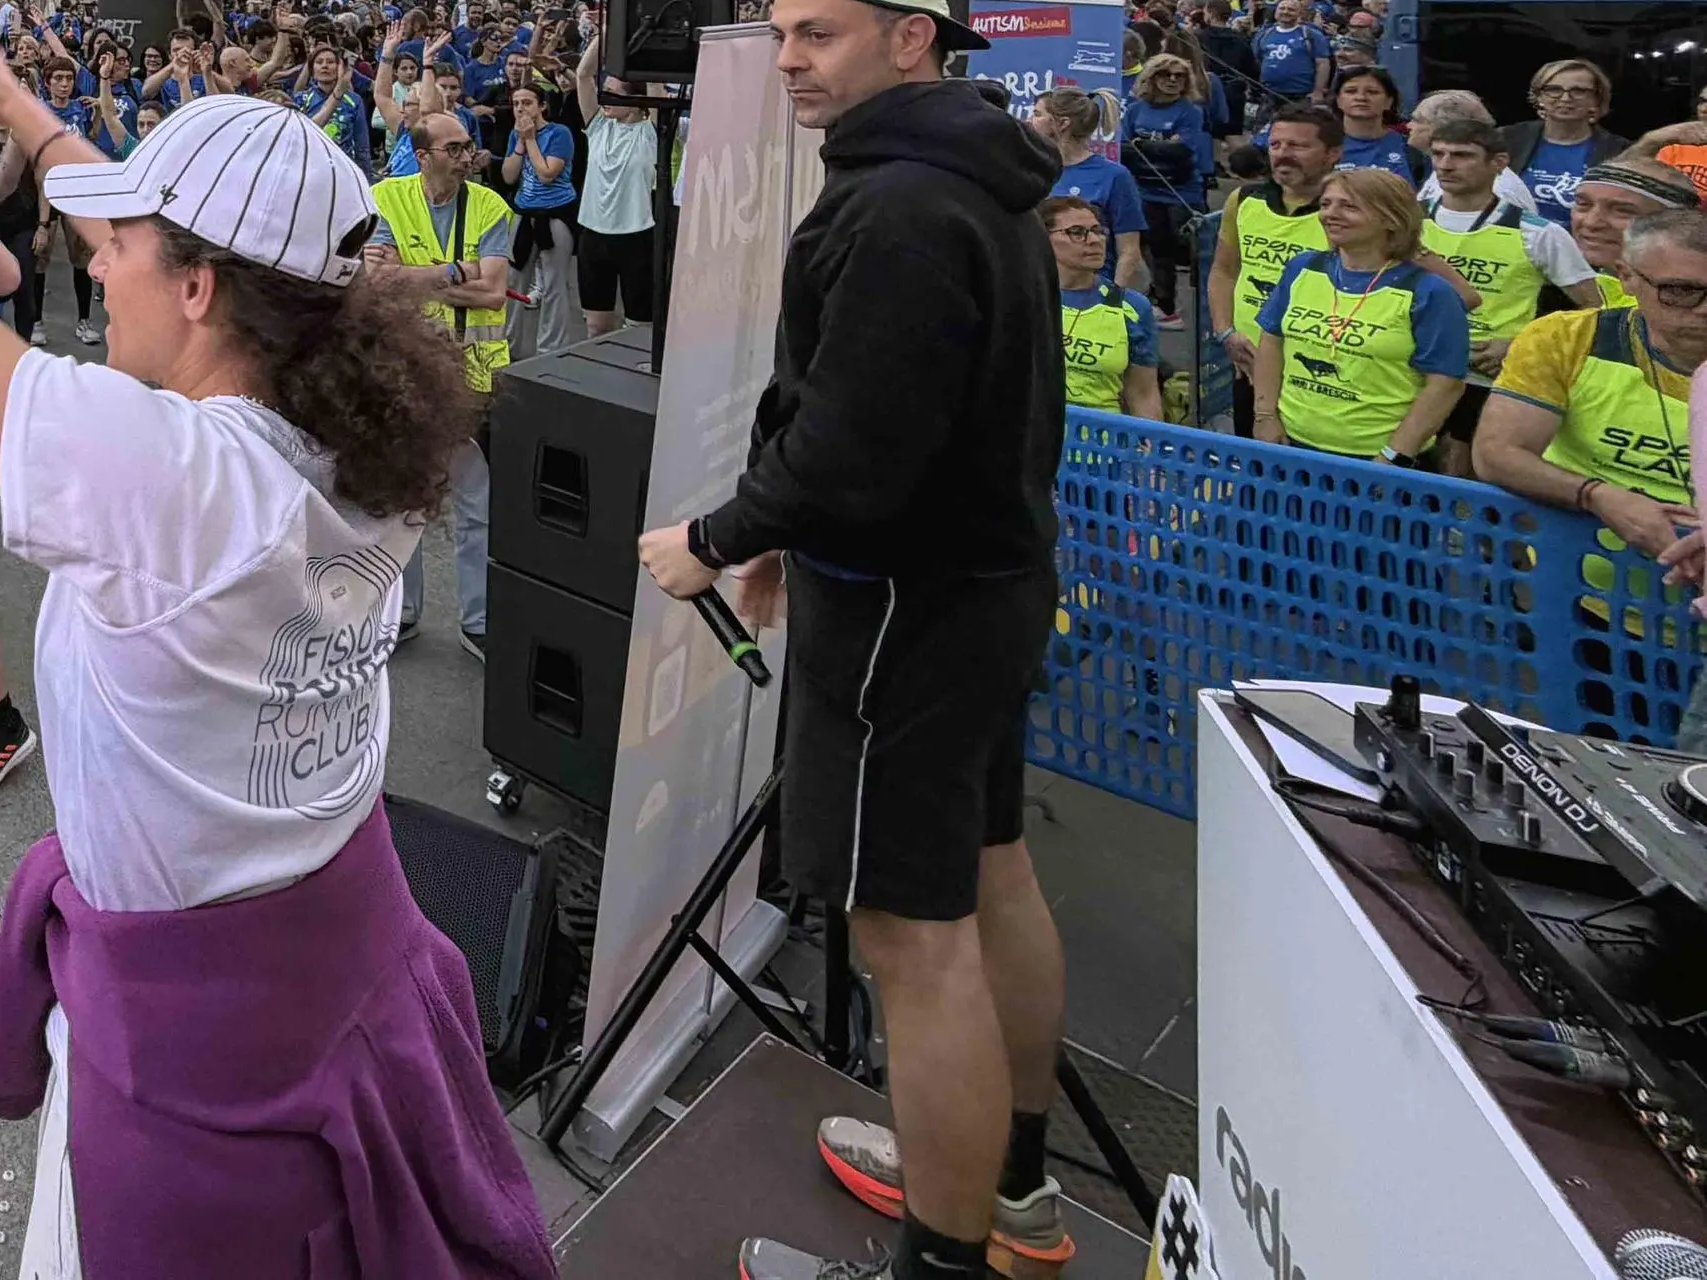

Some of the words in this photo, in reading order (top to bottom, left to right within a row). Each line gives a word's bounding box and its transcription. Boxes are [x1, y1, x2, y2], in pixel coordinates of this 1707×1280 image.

[1244, 247, 1291, 266] LAN
[291, 702, 371, 780] CLUB
[1500, 742, 1571, 807] DENON
[1563, 803, 1600, 833] DJ
